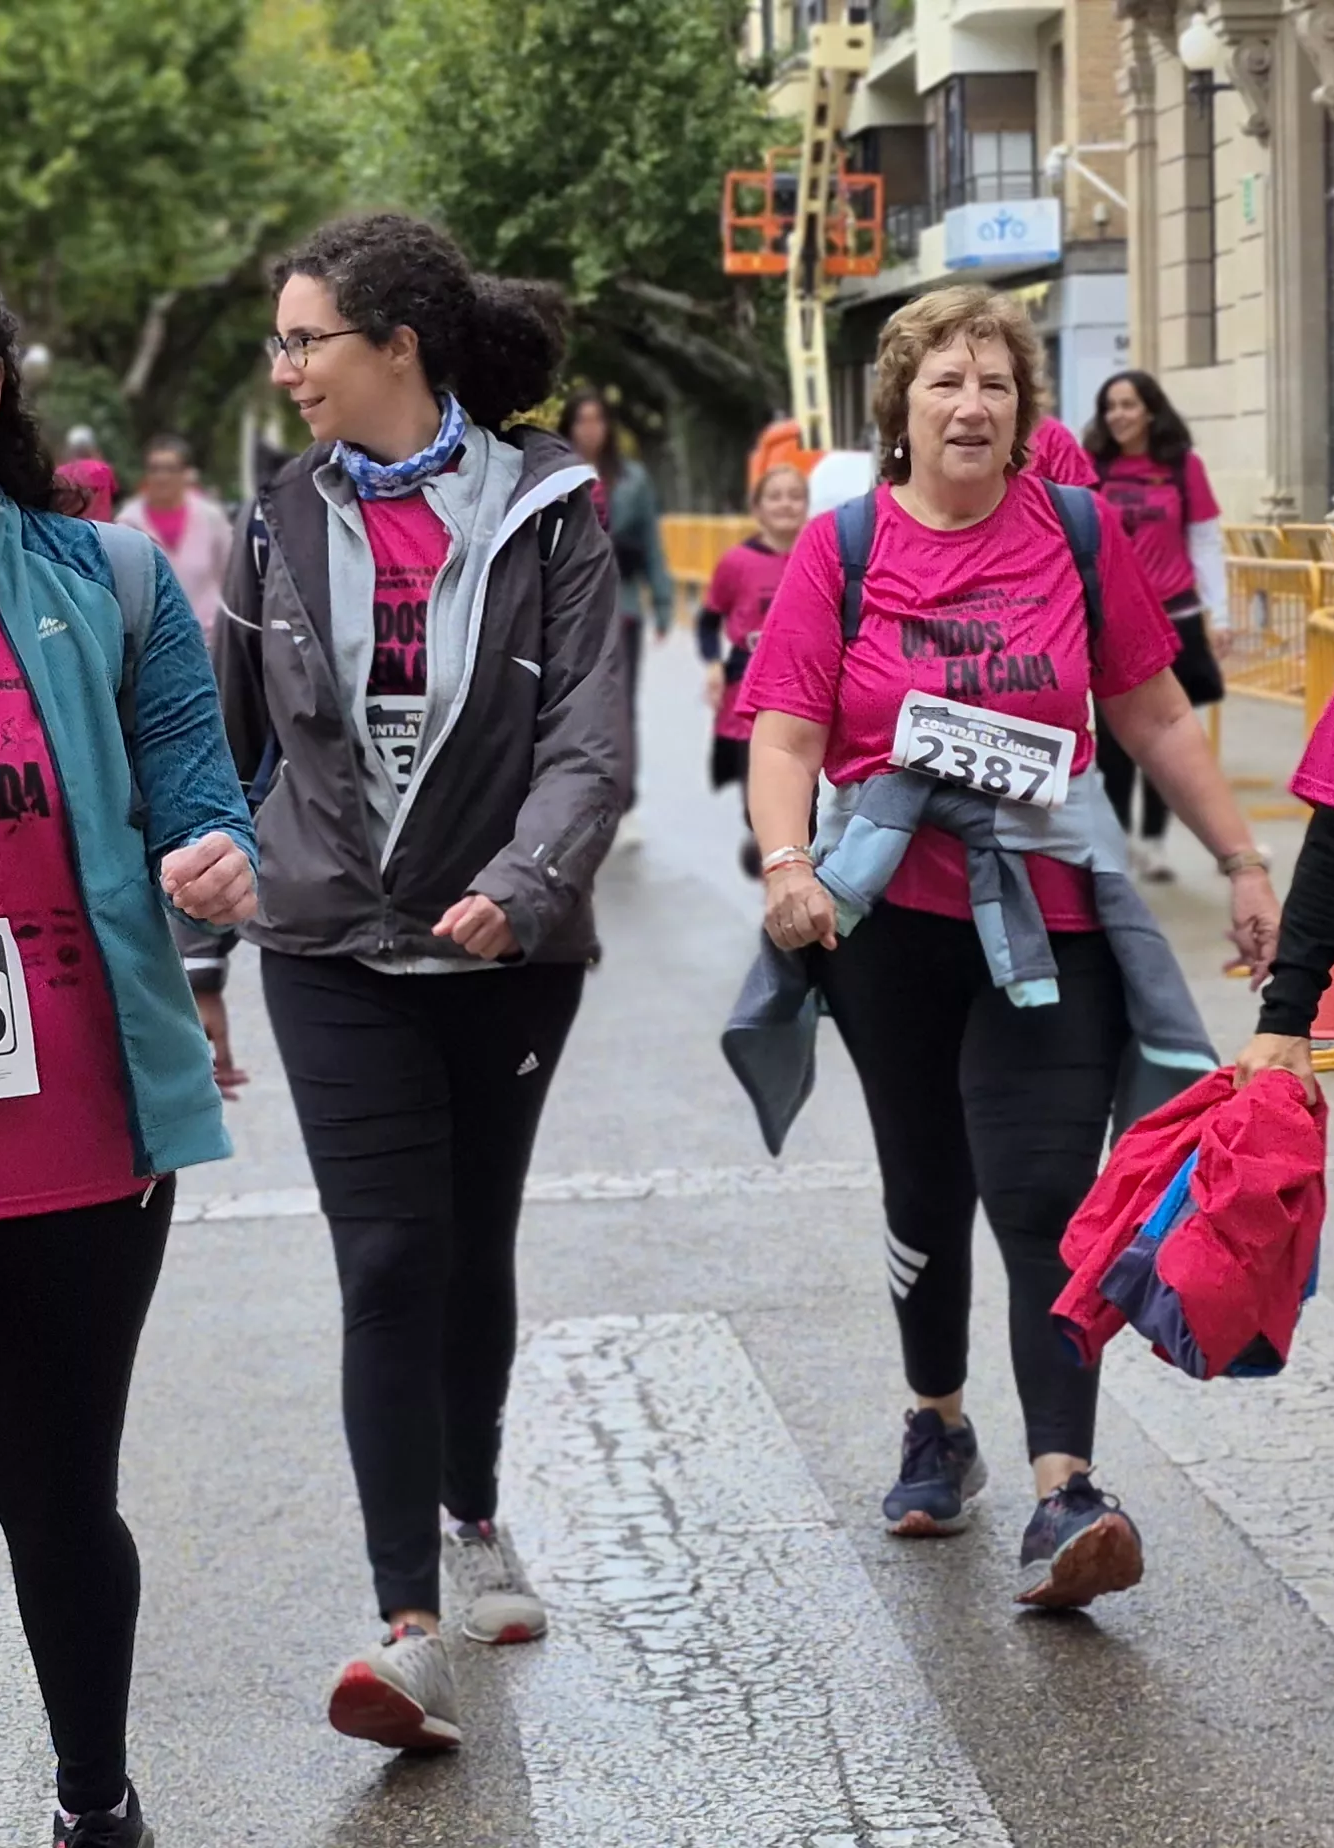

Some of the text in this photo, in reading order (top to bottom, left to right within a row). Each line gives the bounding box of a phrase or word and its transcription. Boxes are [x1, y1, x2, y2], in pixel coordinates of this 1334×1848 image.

[902, 619, 1005, 661] UNIDOS
[946, 652, 1058, 696] EN CADA
[368, 724, 416, 736] ONTRA
[920, 718, 1051, 761] CONTRA EL CÁNCER
[909, 735, 1050, 801] 2387
